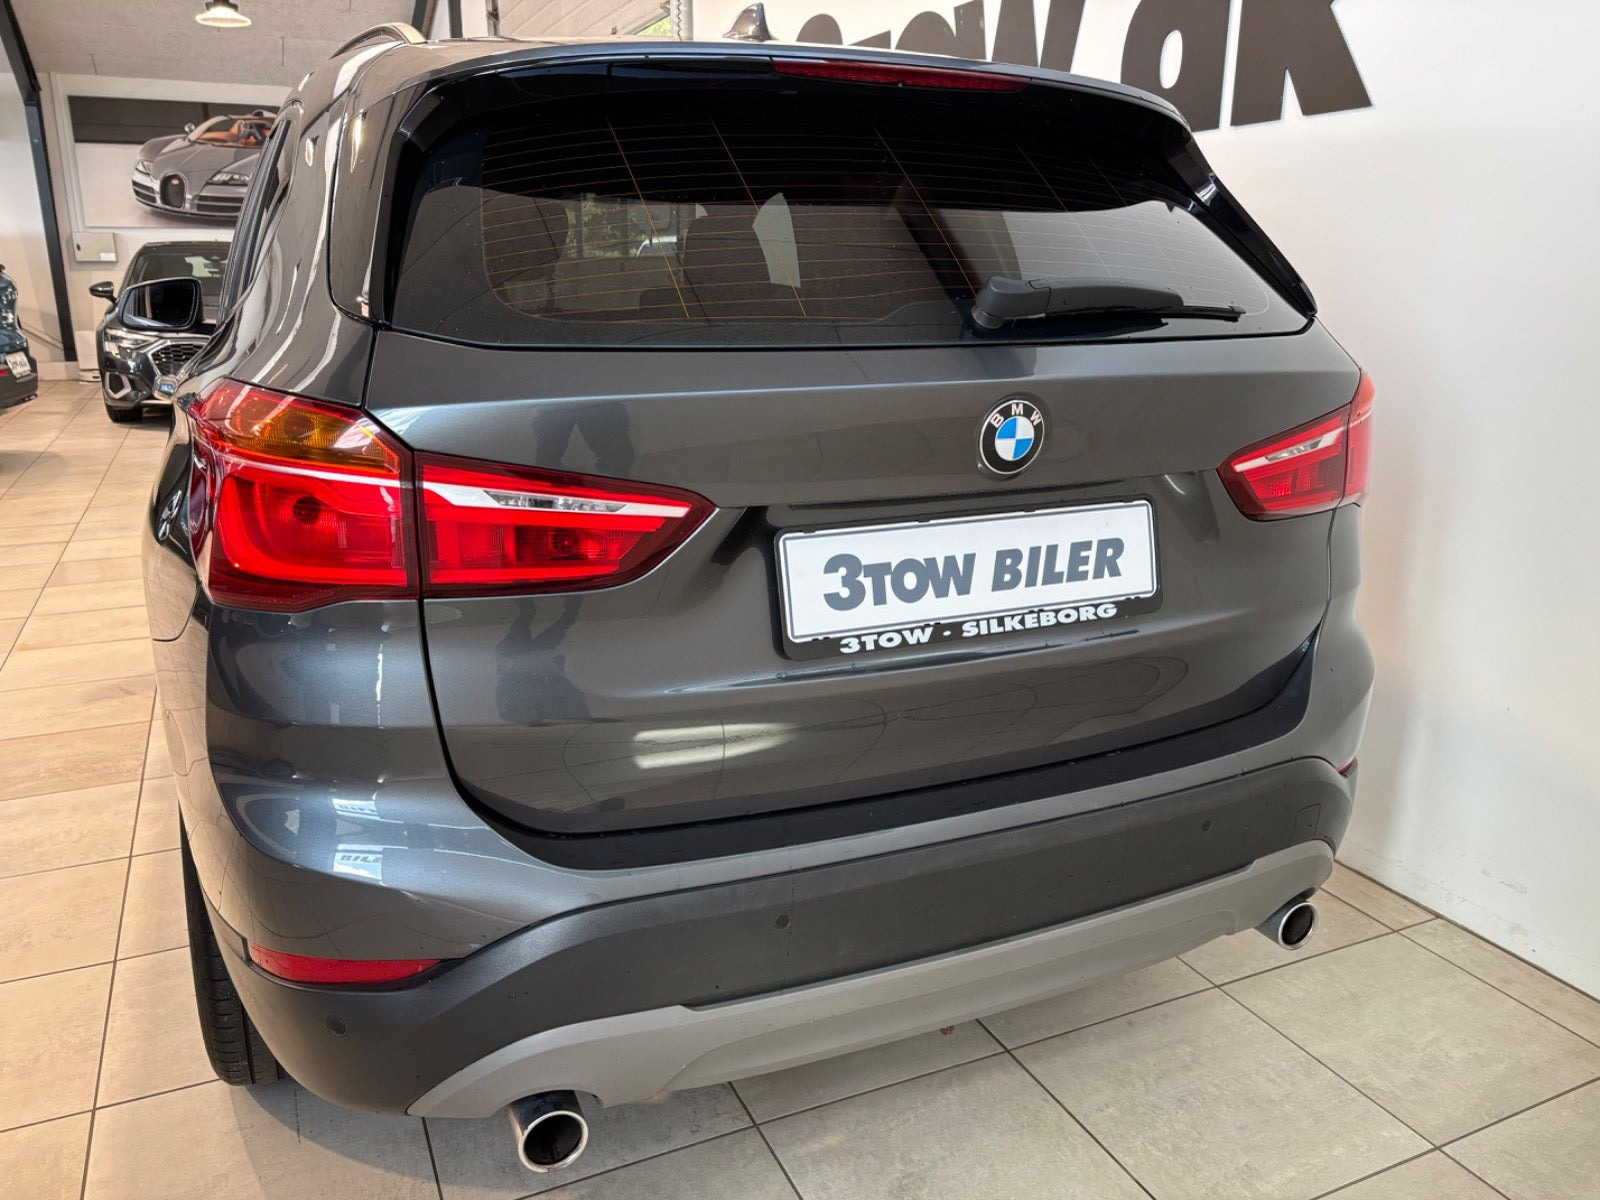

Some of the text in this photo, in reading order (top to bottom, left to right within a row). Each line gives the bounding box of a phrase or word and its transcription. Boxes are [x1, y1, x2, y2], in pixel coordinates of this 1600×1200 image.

[990, 403, 1042, 428] BMW
[823, 538, 1125, 611] 3TOW BILER
[839, 604, 1118, 654] 3TOW SILKEBORG
